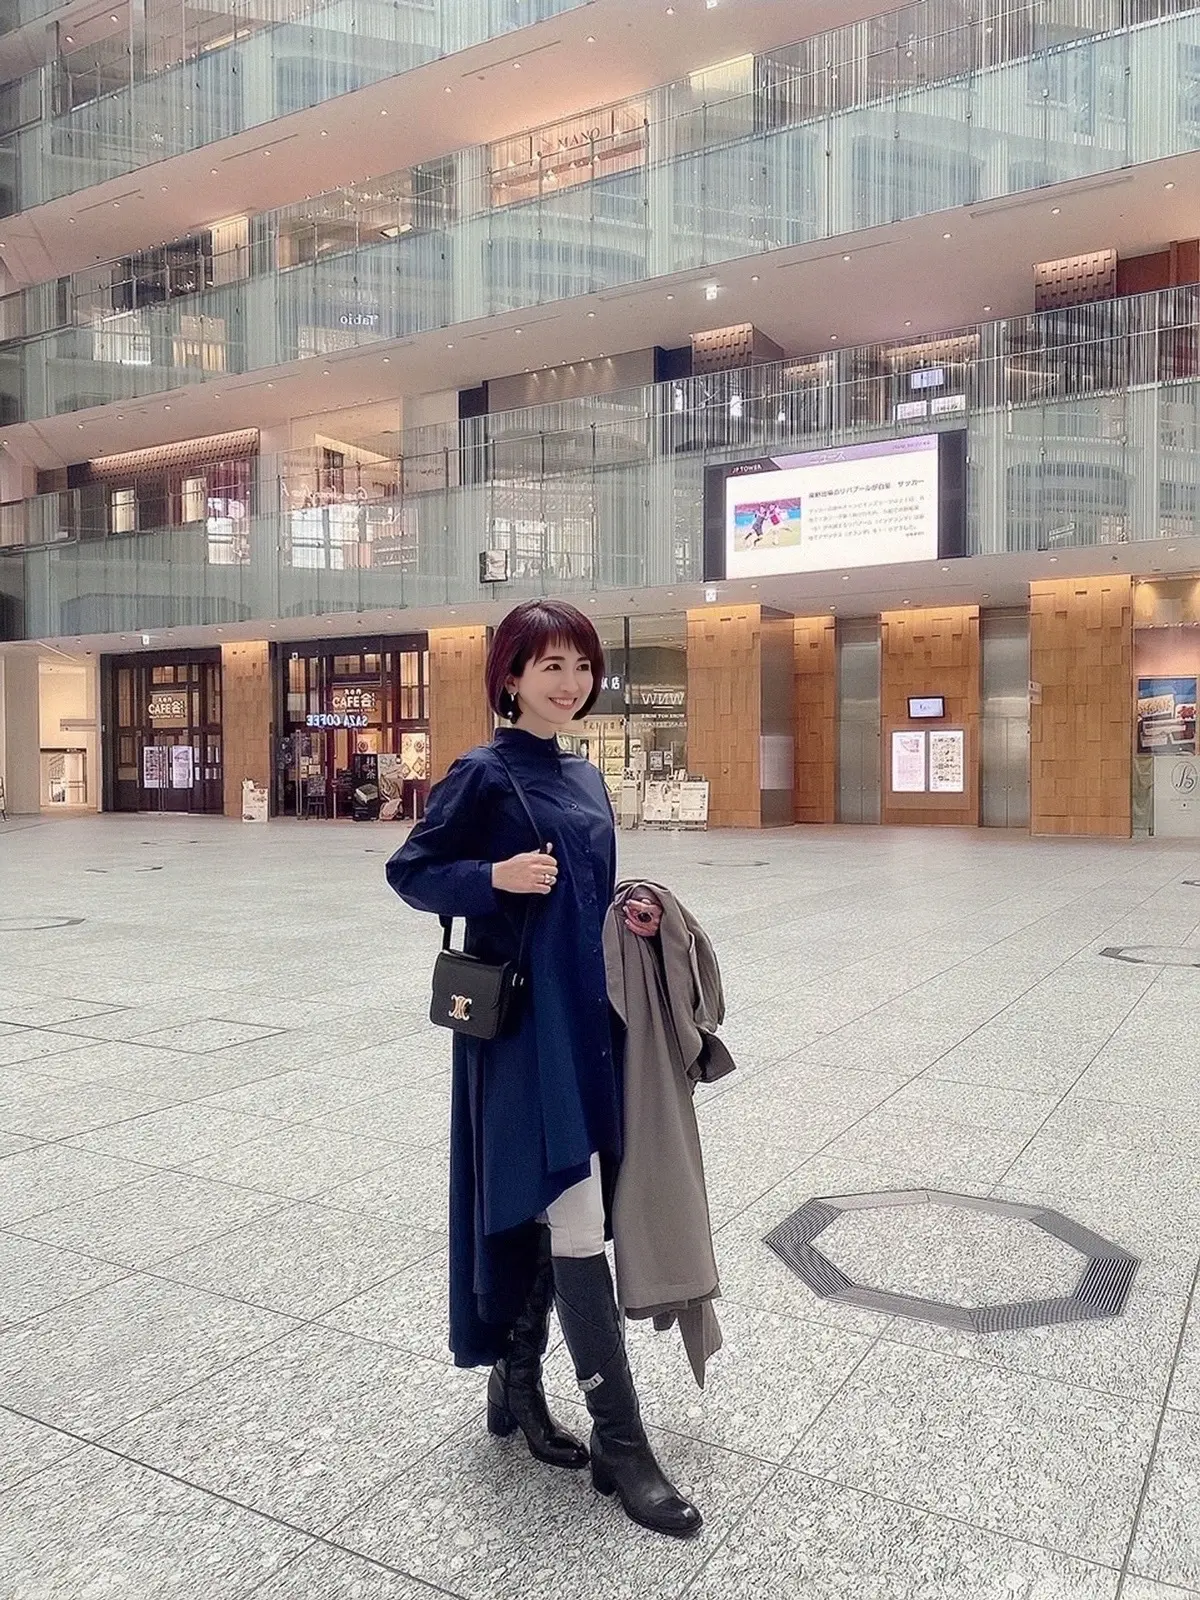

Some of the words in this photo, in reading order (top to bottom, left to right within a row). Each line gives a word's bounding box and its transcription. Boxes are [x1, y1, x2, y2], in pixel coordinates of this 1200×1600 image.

[740, 464, 762, 472] TOWER
[332, 696, 360, 708] CAFE
[148, 703, 171, 715] CAFE
